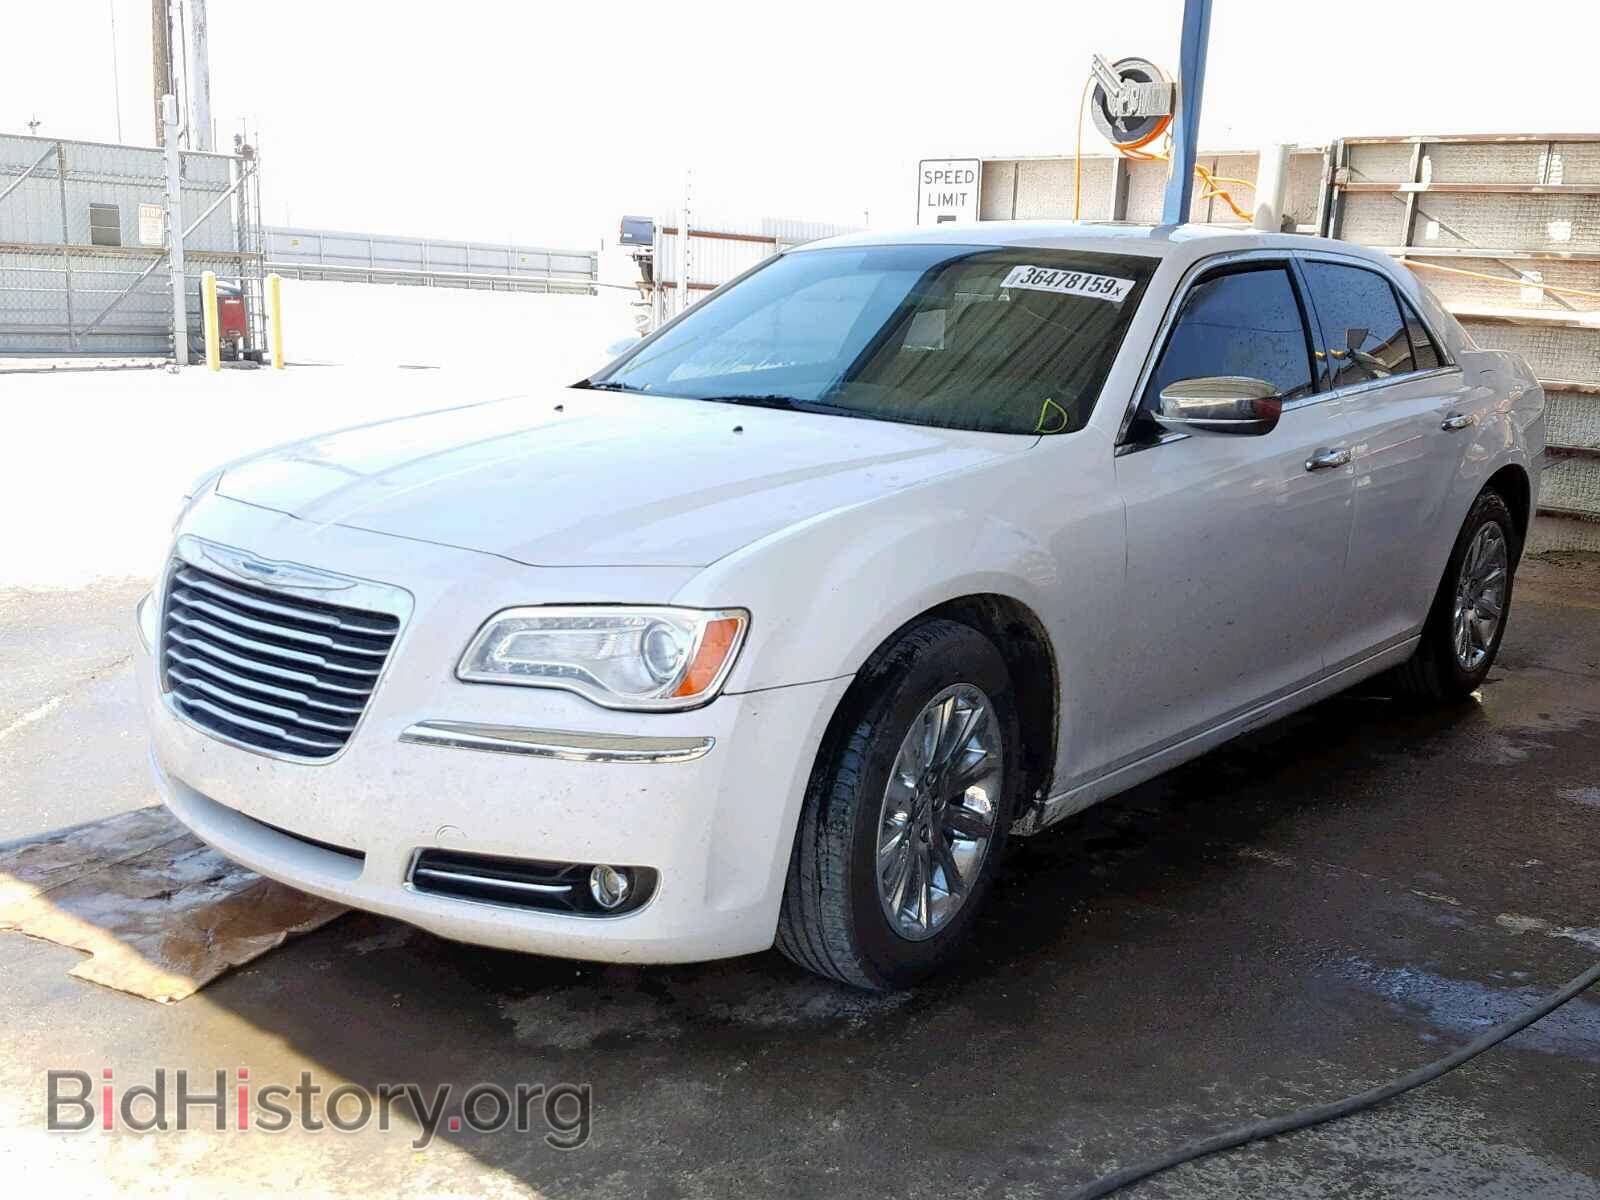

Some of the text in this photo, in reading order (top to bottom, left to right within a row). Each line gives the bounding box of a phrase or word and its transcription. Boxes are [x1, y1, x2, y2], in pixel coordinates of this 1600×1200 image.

[924, 170, 975, 184] SPEED
[928, 192, 968, 207] LIMIT
[1033, 398, 1068, 433] D
